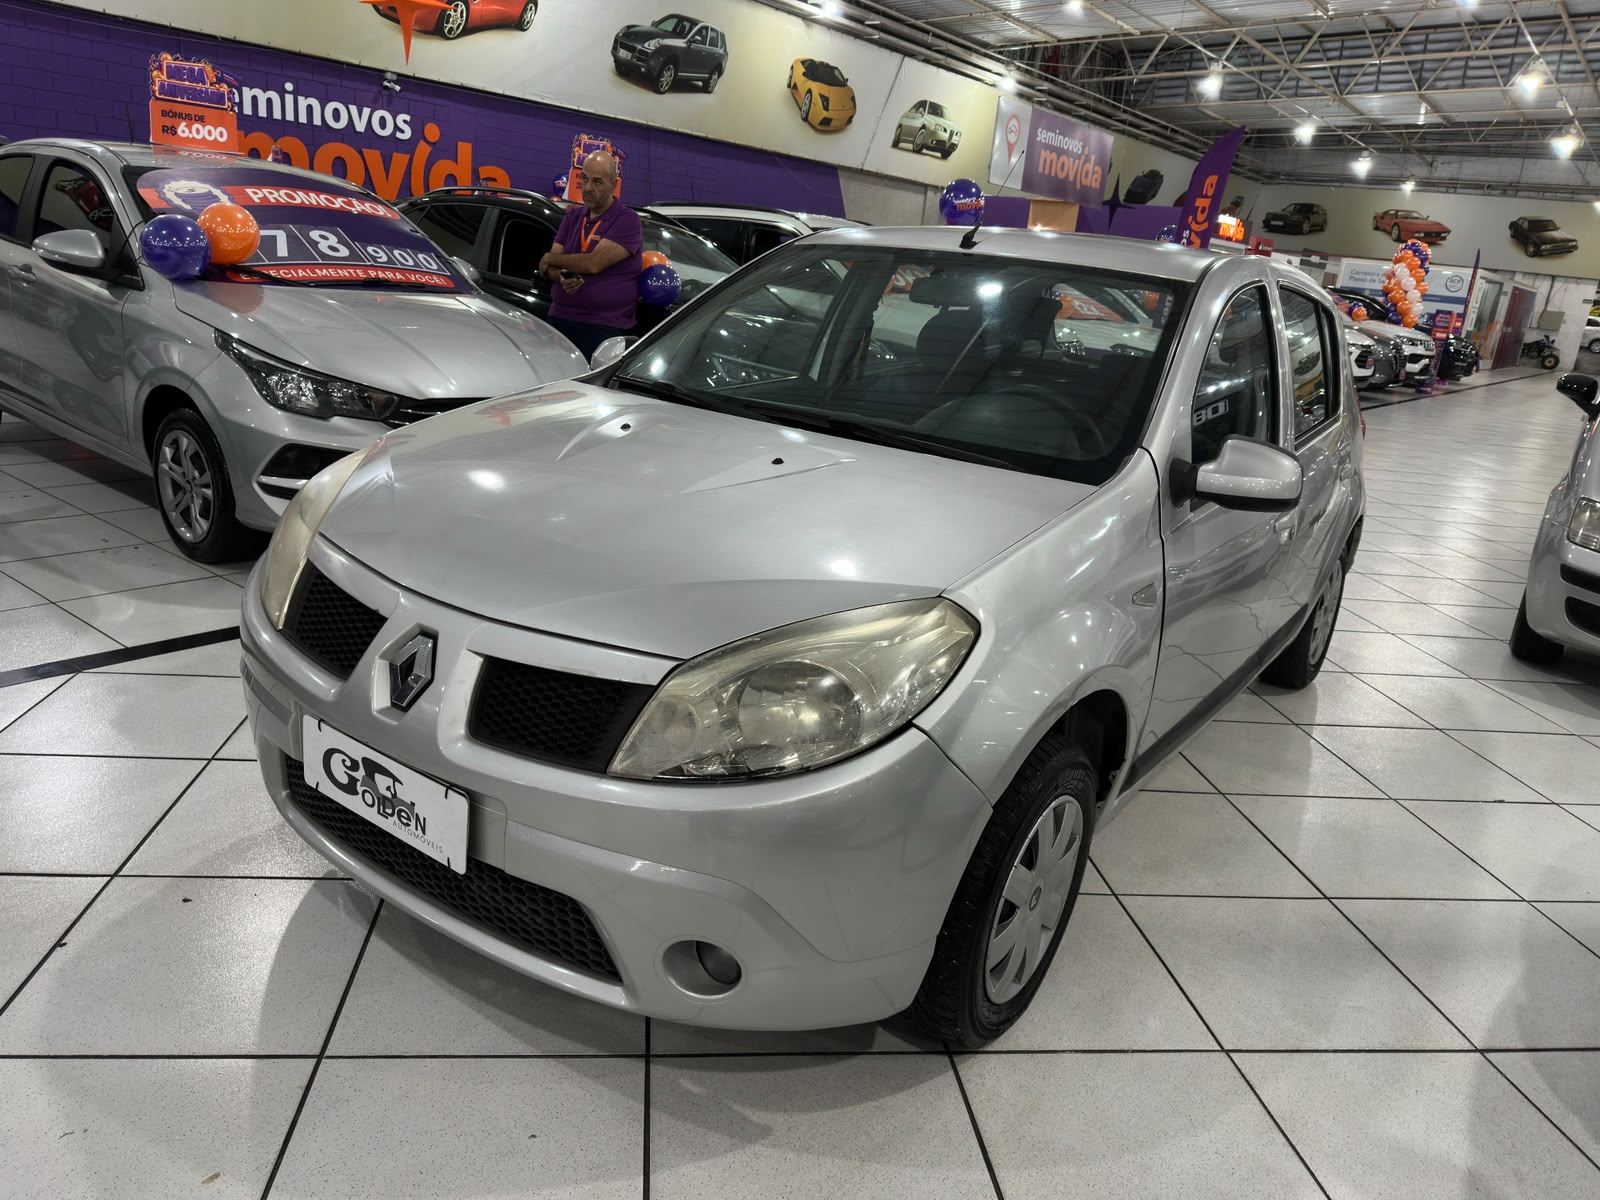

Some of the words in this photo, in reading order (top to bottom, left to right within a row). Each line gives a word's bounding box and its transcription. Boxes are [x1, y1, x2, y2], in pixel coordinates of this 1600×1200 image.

[161, 109, 193, 121] BÔNUS
[194, 114, 206, 122] DE
[1036, 128, 1083, 154] seminovos
[238, 122, 511, 201] movida
[1039, 146, 1102, 190] movida
[244, 188, 391, 217] PROMOÇÃO!
[240, 268, 364, 280] EECIALMENTE
[370, 270, 403, 281] PARA
